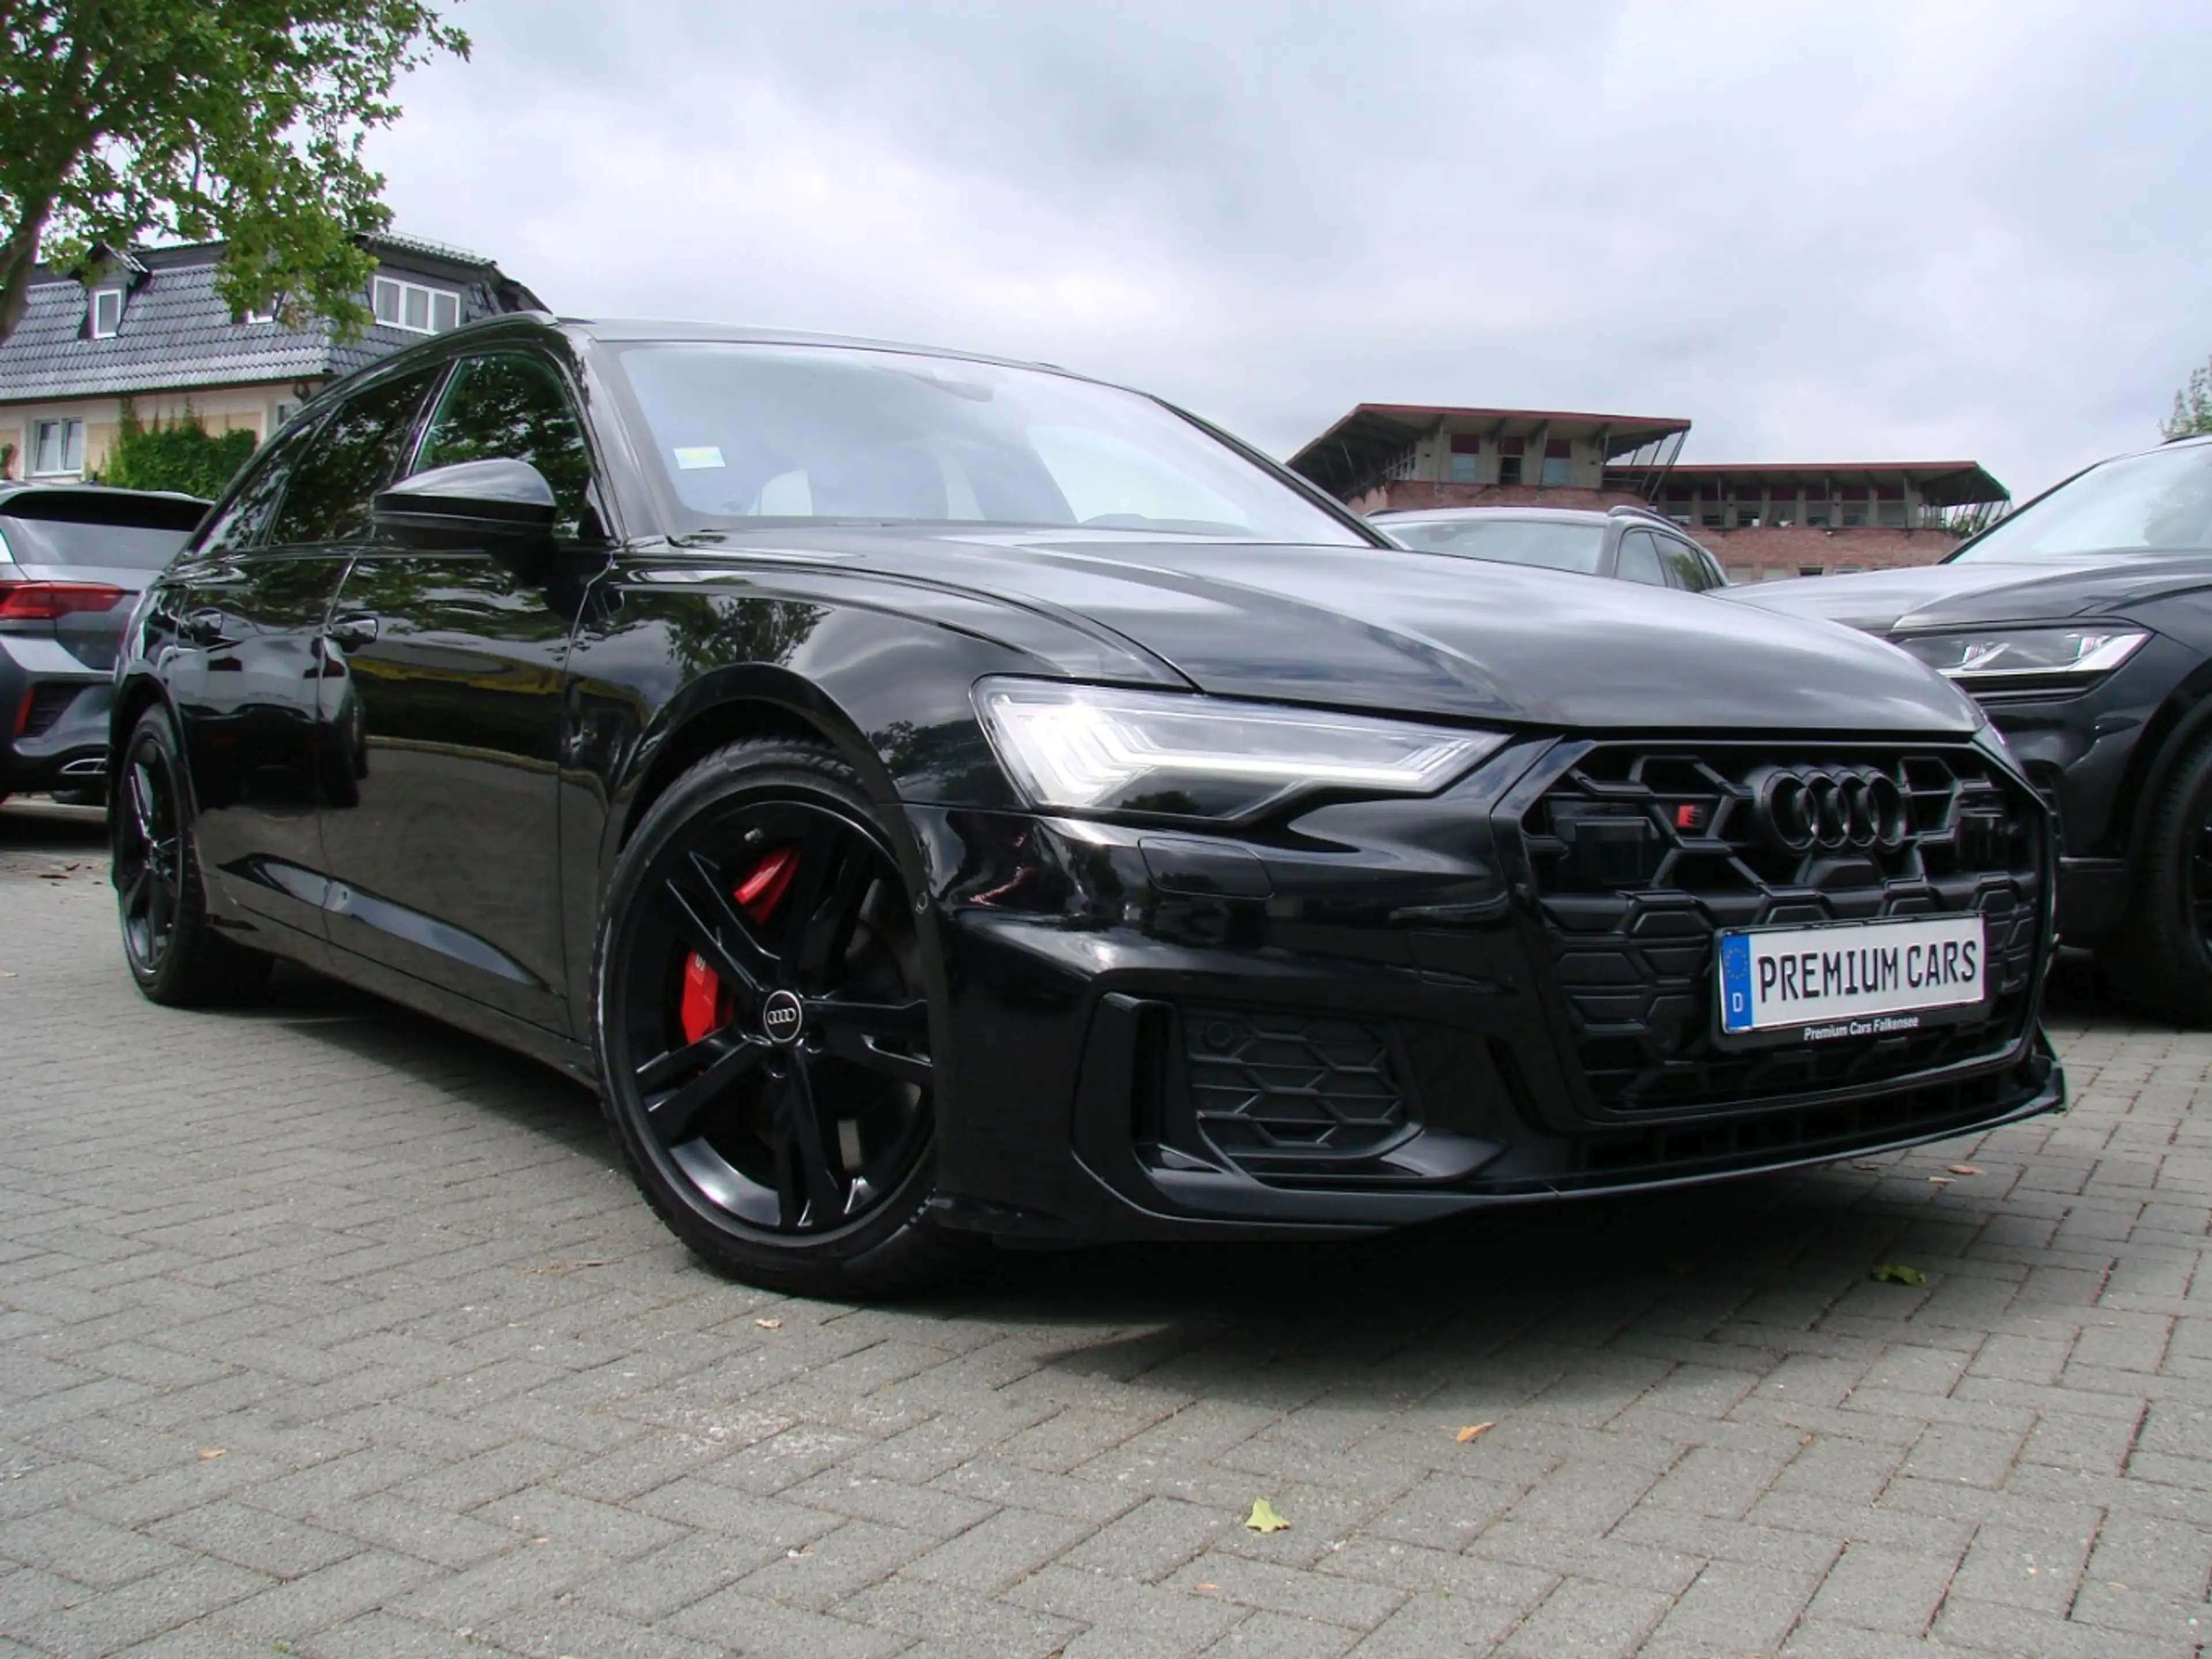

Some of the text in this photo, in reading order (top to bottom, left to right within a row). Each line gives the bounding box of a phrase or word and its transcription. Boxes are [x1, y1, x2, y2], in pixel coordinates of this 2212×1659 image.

[1757, 940, 1976, 1003] PREMIUM CARS
[1731, 993, 1744, 1013] D
[1804, 1016, 1919, 1041] Premium Cars Falkensee
